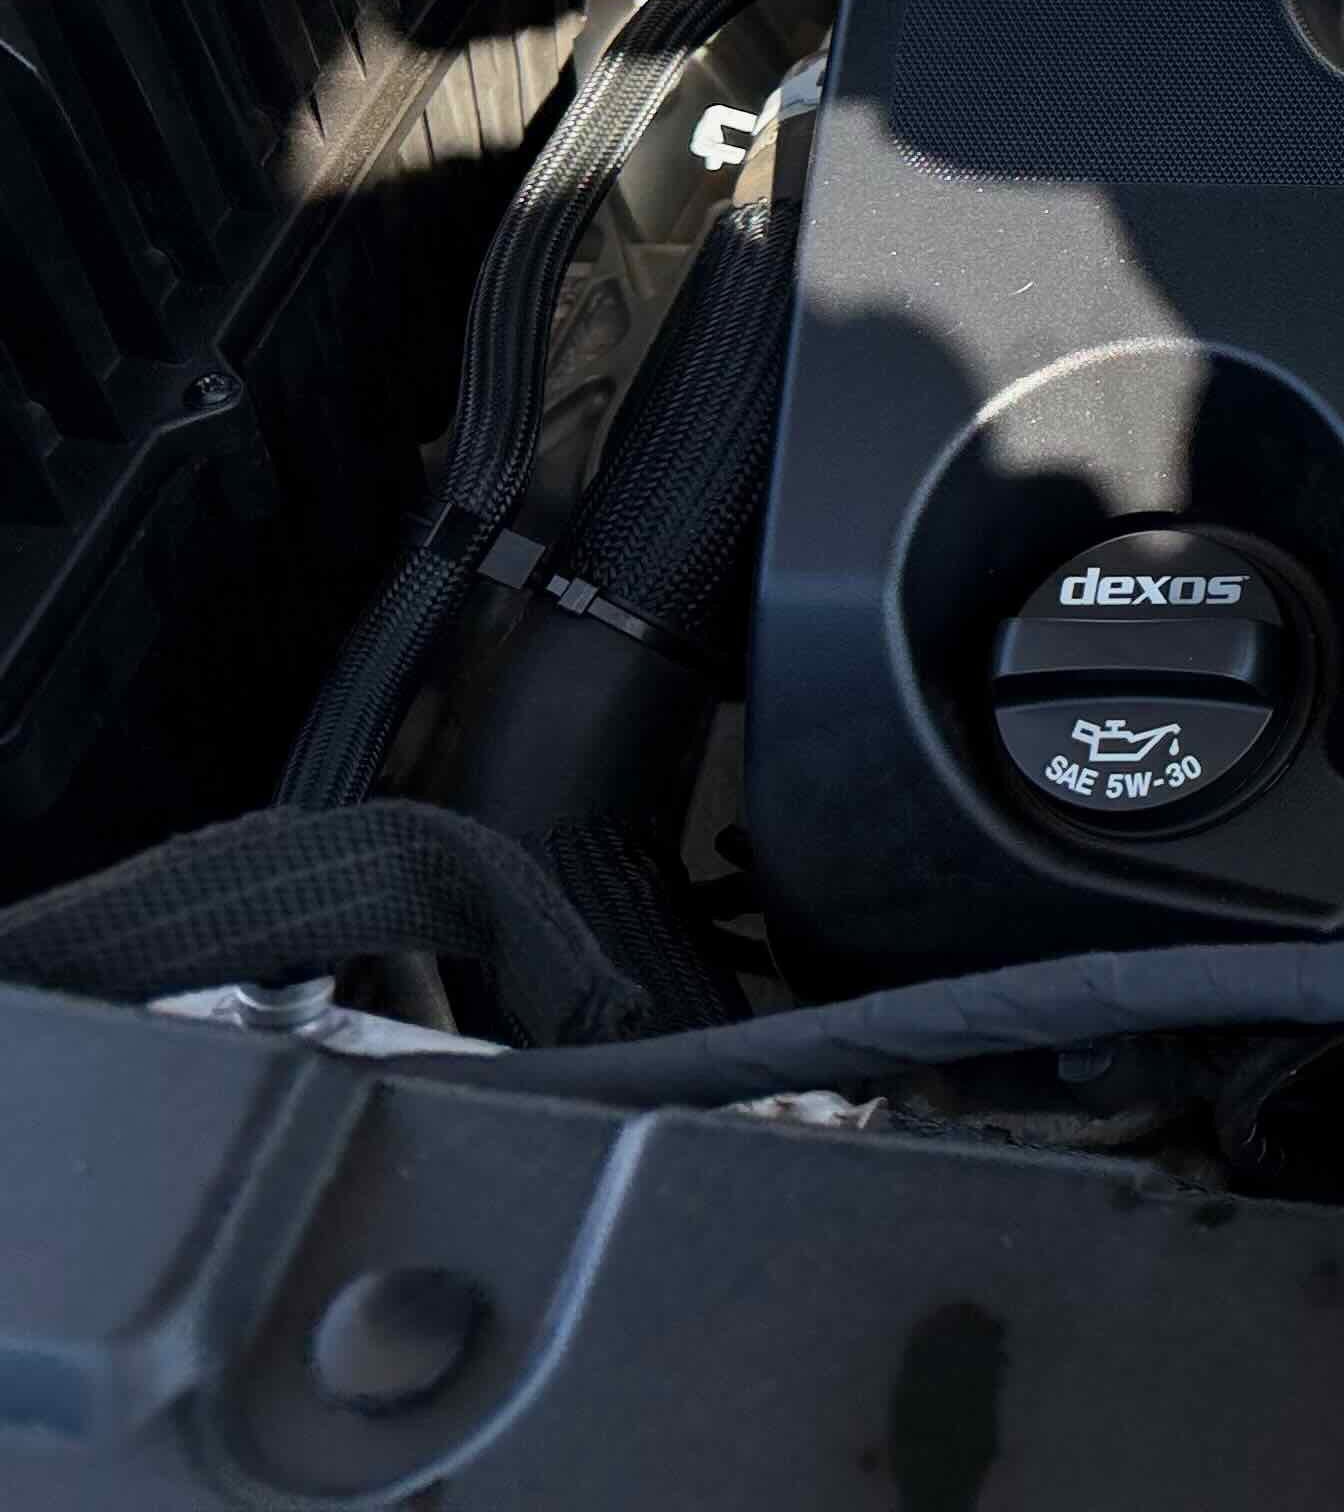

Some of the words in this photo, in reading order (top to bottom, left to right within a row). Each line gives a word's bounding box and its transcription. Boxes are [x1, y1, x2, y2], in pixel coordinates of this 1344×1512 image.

[1060, 567, 1246, 606] dexos
[1045, 755, 1099, 796] SAE
[1105, 755, 1202, 799] 5W-30
